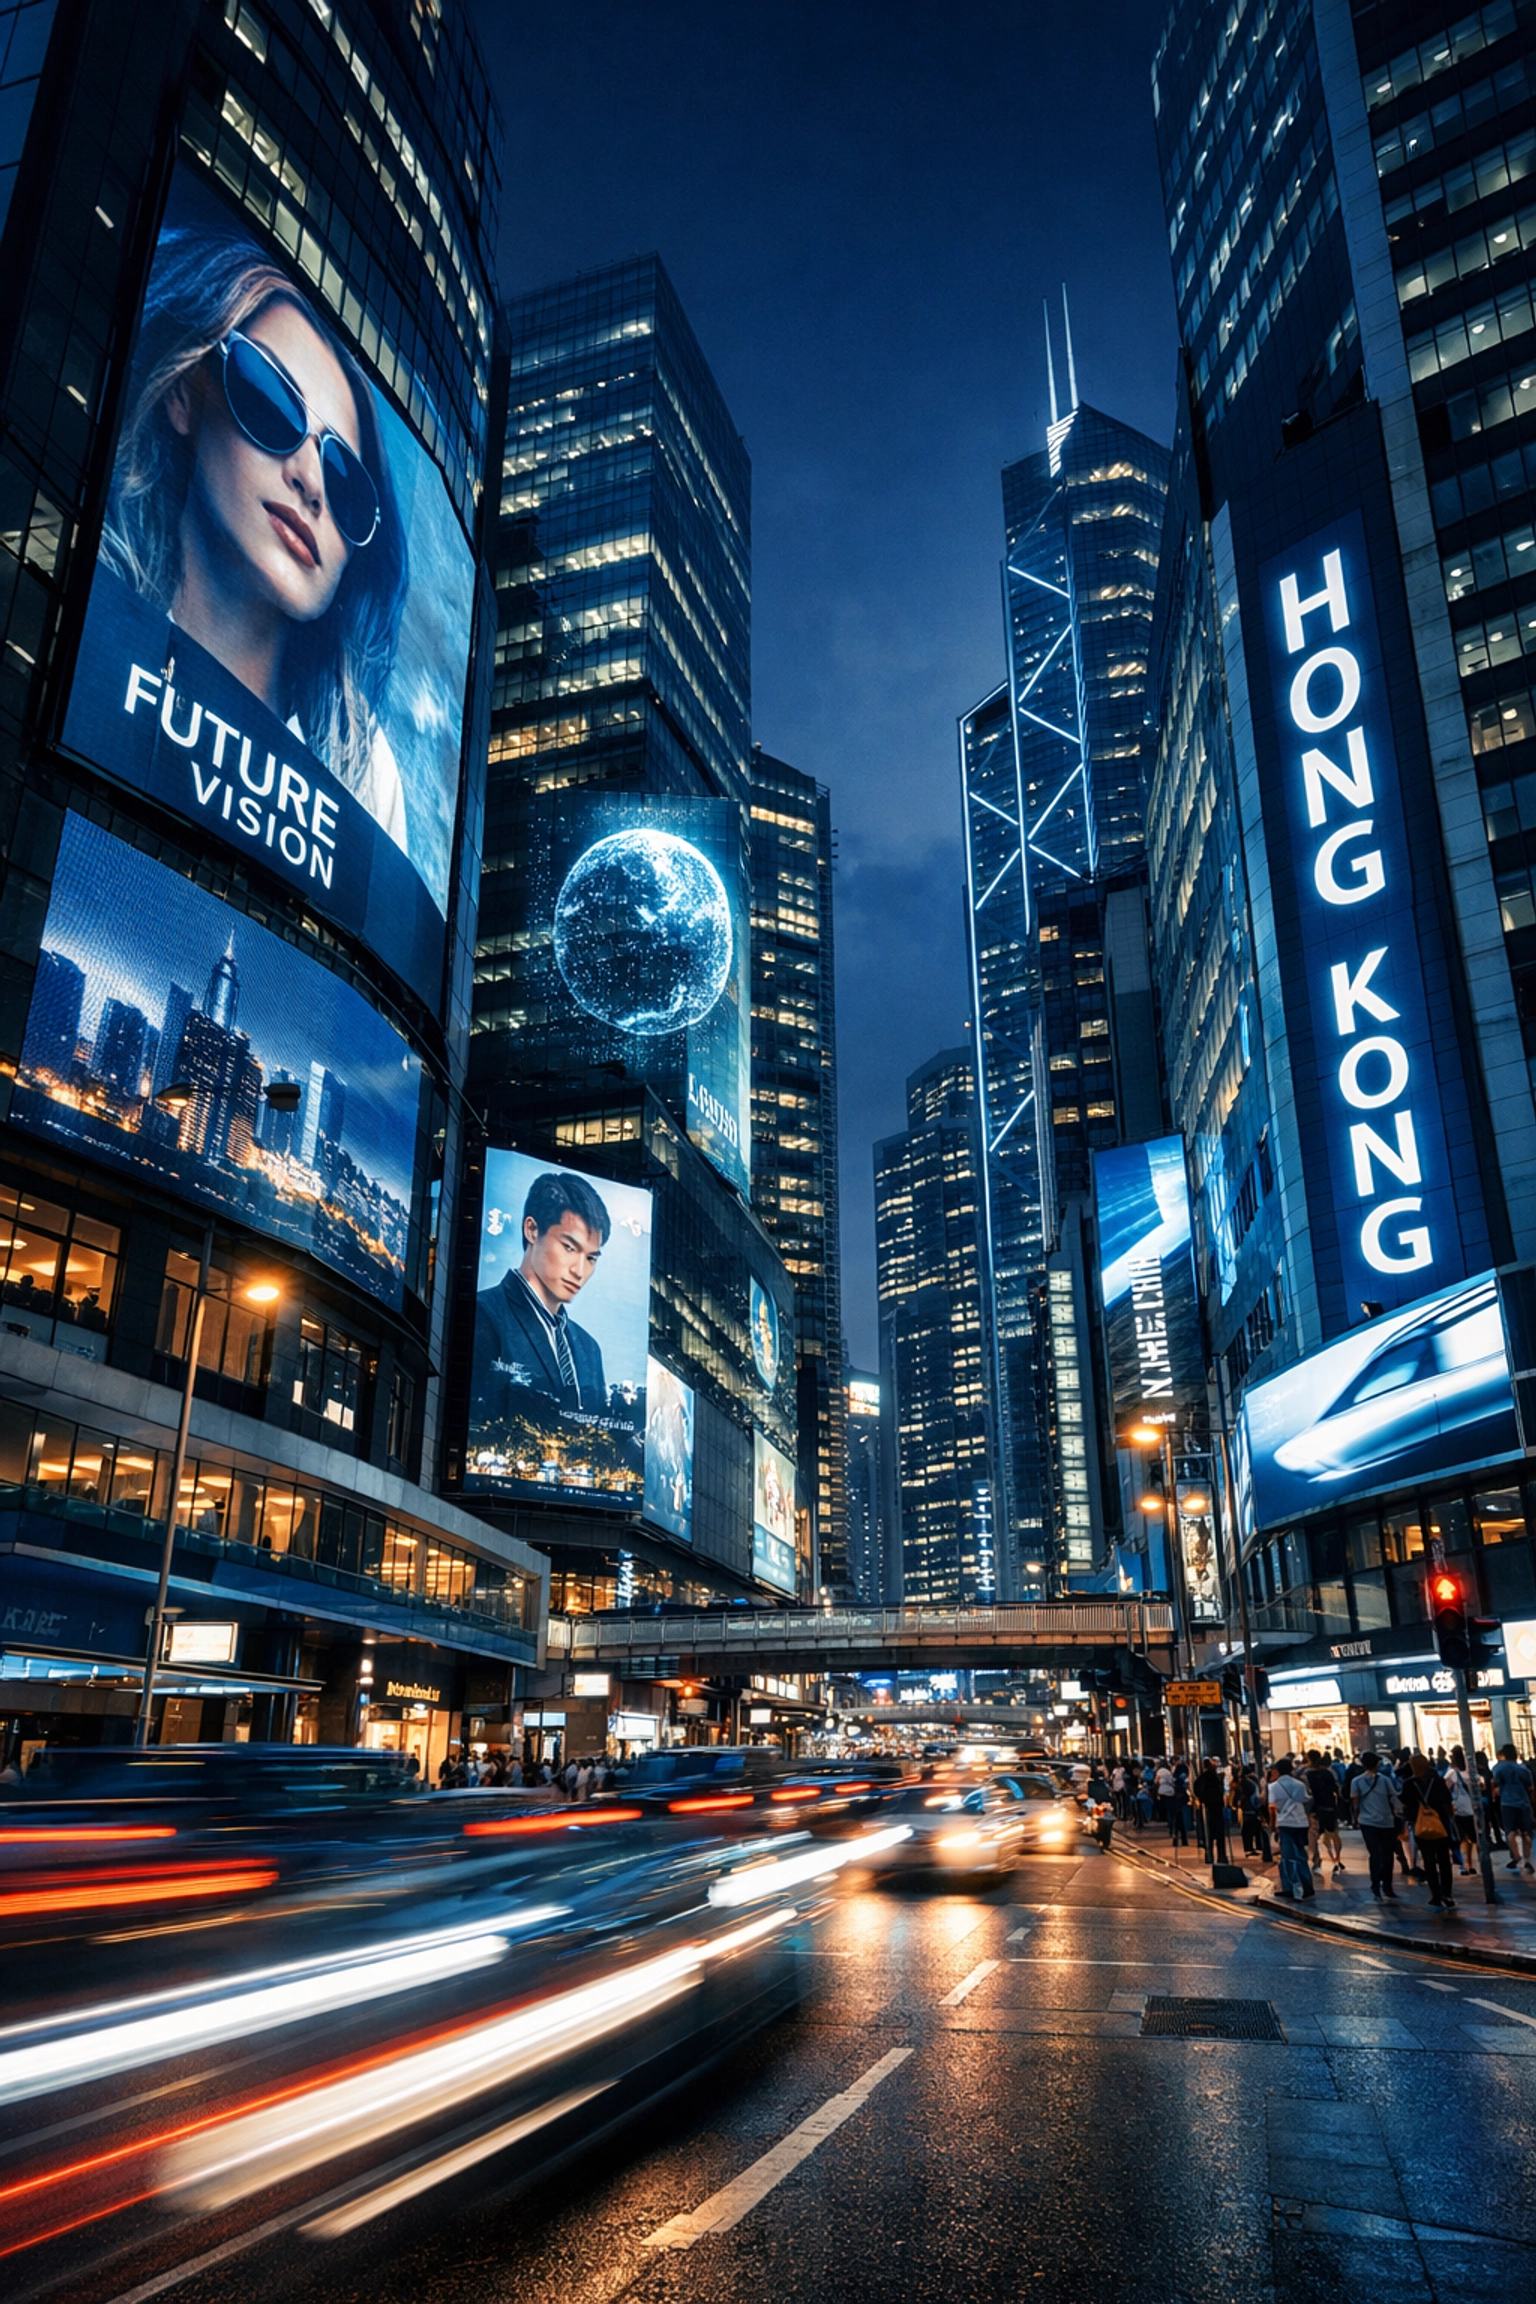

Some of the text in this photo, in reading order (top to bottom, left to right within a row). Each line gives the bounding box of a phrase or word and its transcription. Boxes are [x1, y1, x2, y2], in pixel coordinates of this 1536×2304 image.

[123, 662, 341, 850] FUTURE
[190, 760, 335, 890] VISION
[1278, 548, 1434, 1275] HONG KONG
